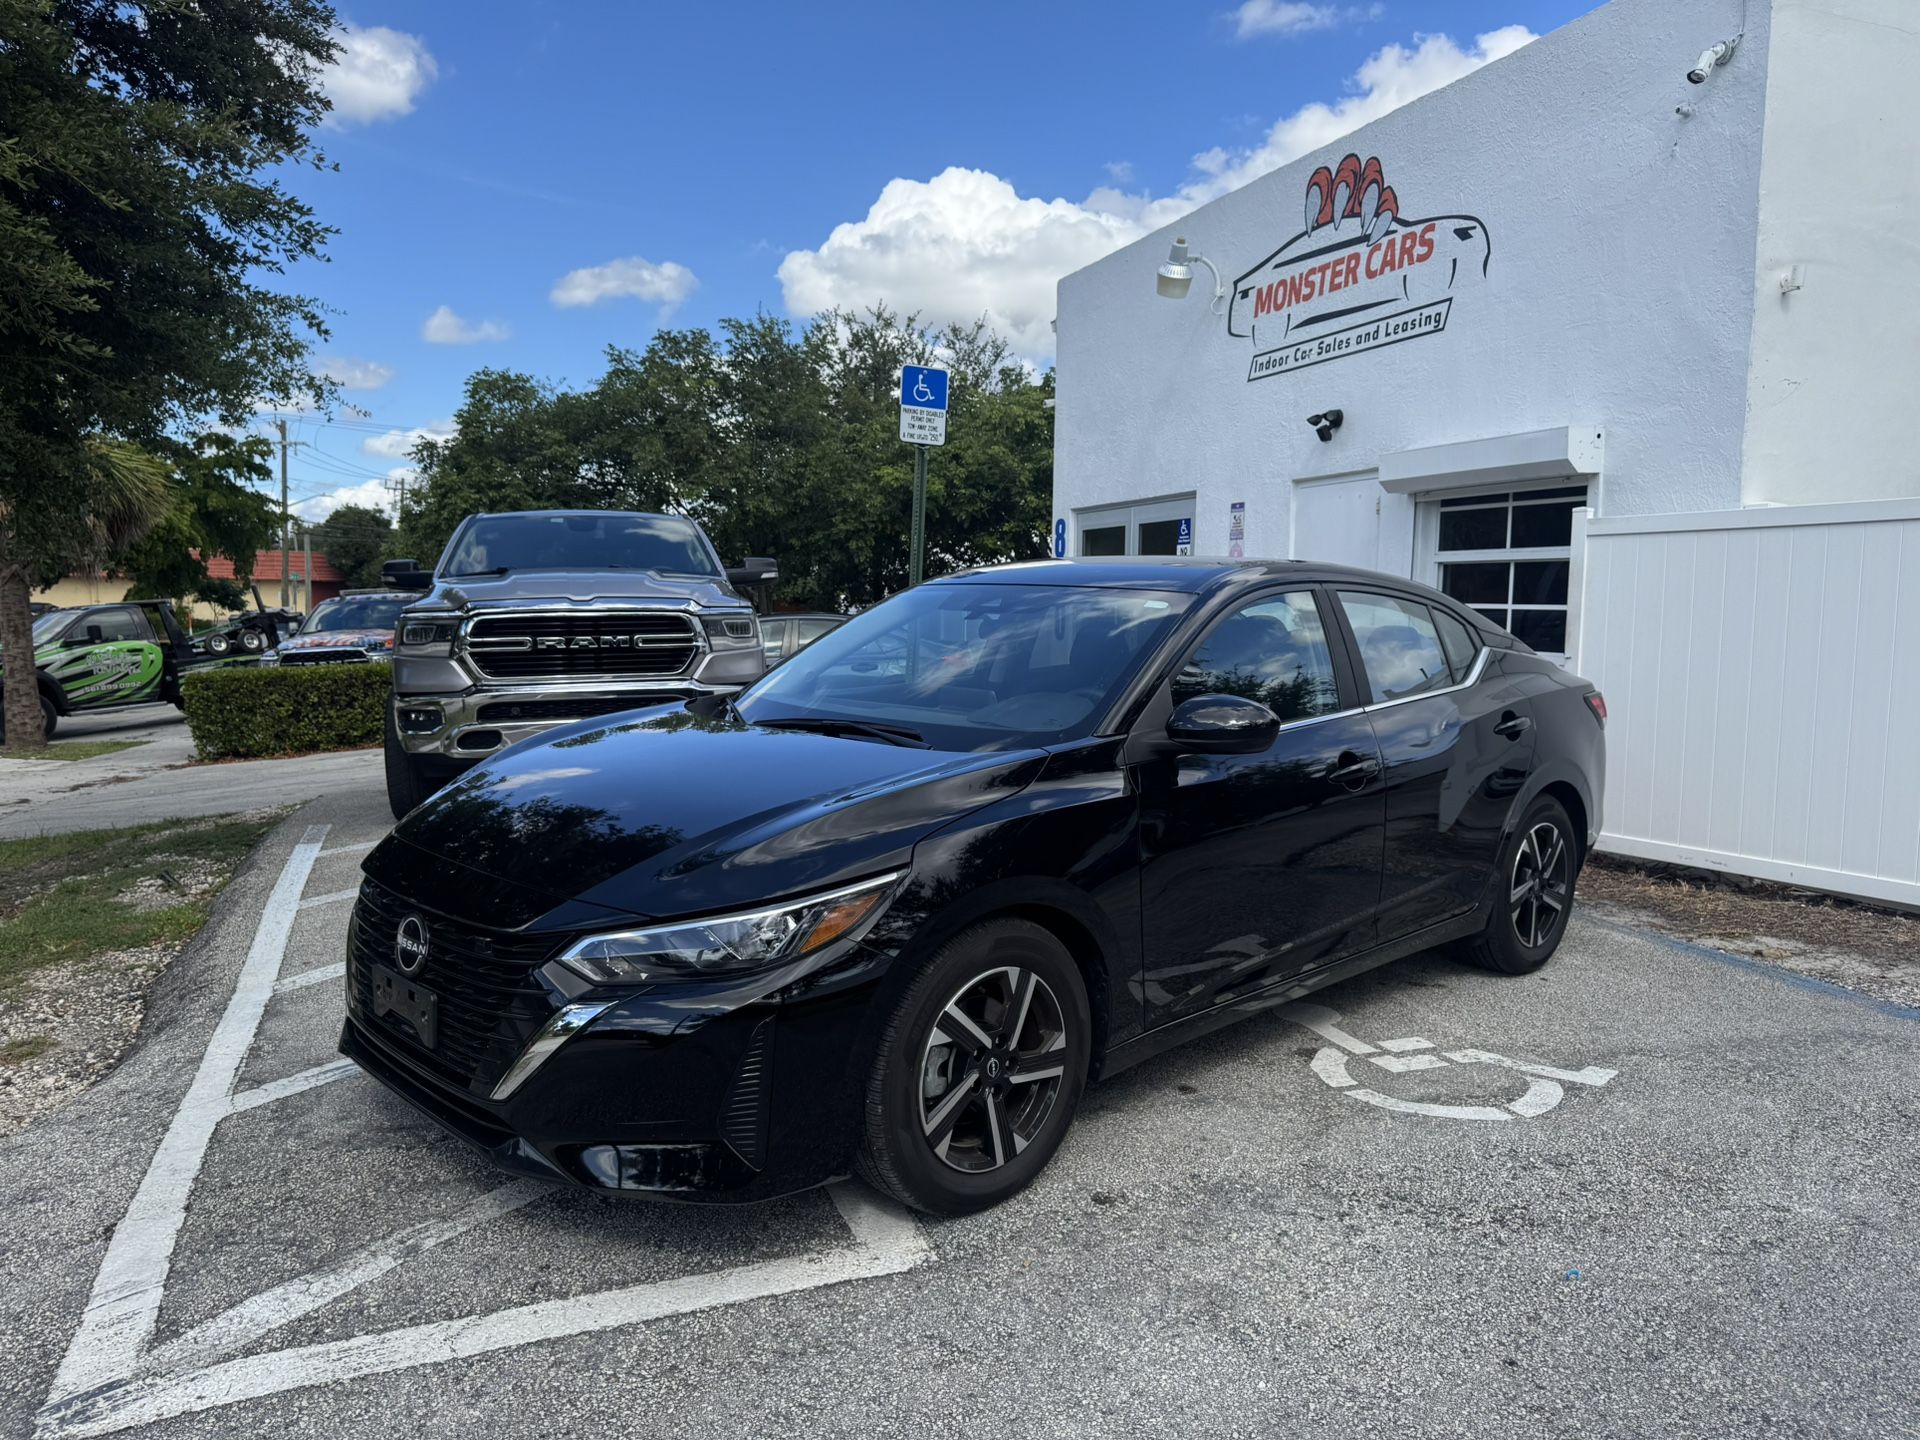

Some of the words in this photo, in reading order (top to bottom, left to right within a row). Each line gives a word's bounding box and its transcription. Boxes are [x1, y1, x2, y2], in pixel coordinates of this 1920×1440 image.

[1253, 252, 1361, 319] MONSTER
[1365, 222, 1437, 280] CARS
[1253, 355, 1290, 373] Indoor
[1294, 347, 1314, 360] Car
[1316, 337, 1351, 356] Sales
[1355, 324, 1380, 345] and
[1384, 311, 1442, 337] Leasing
[902, 407, 919, 415] PARKING
[926, 410, 944, 418] DISABLED
[536, 635, 630, 648] RAM
